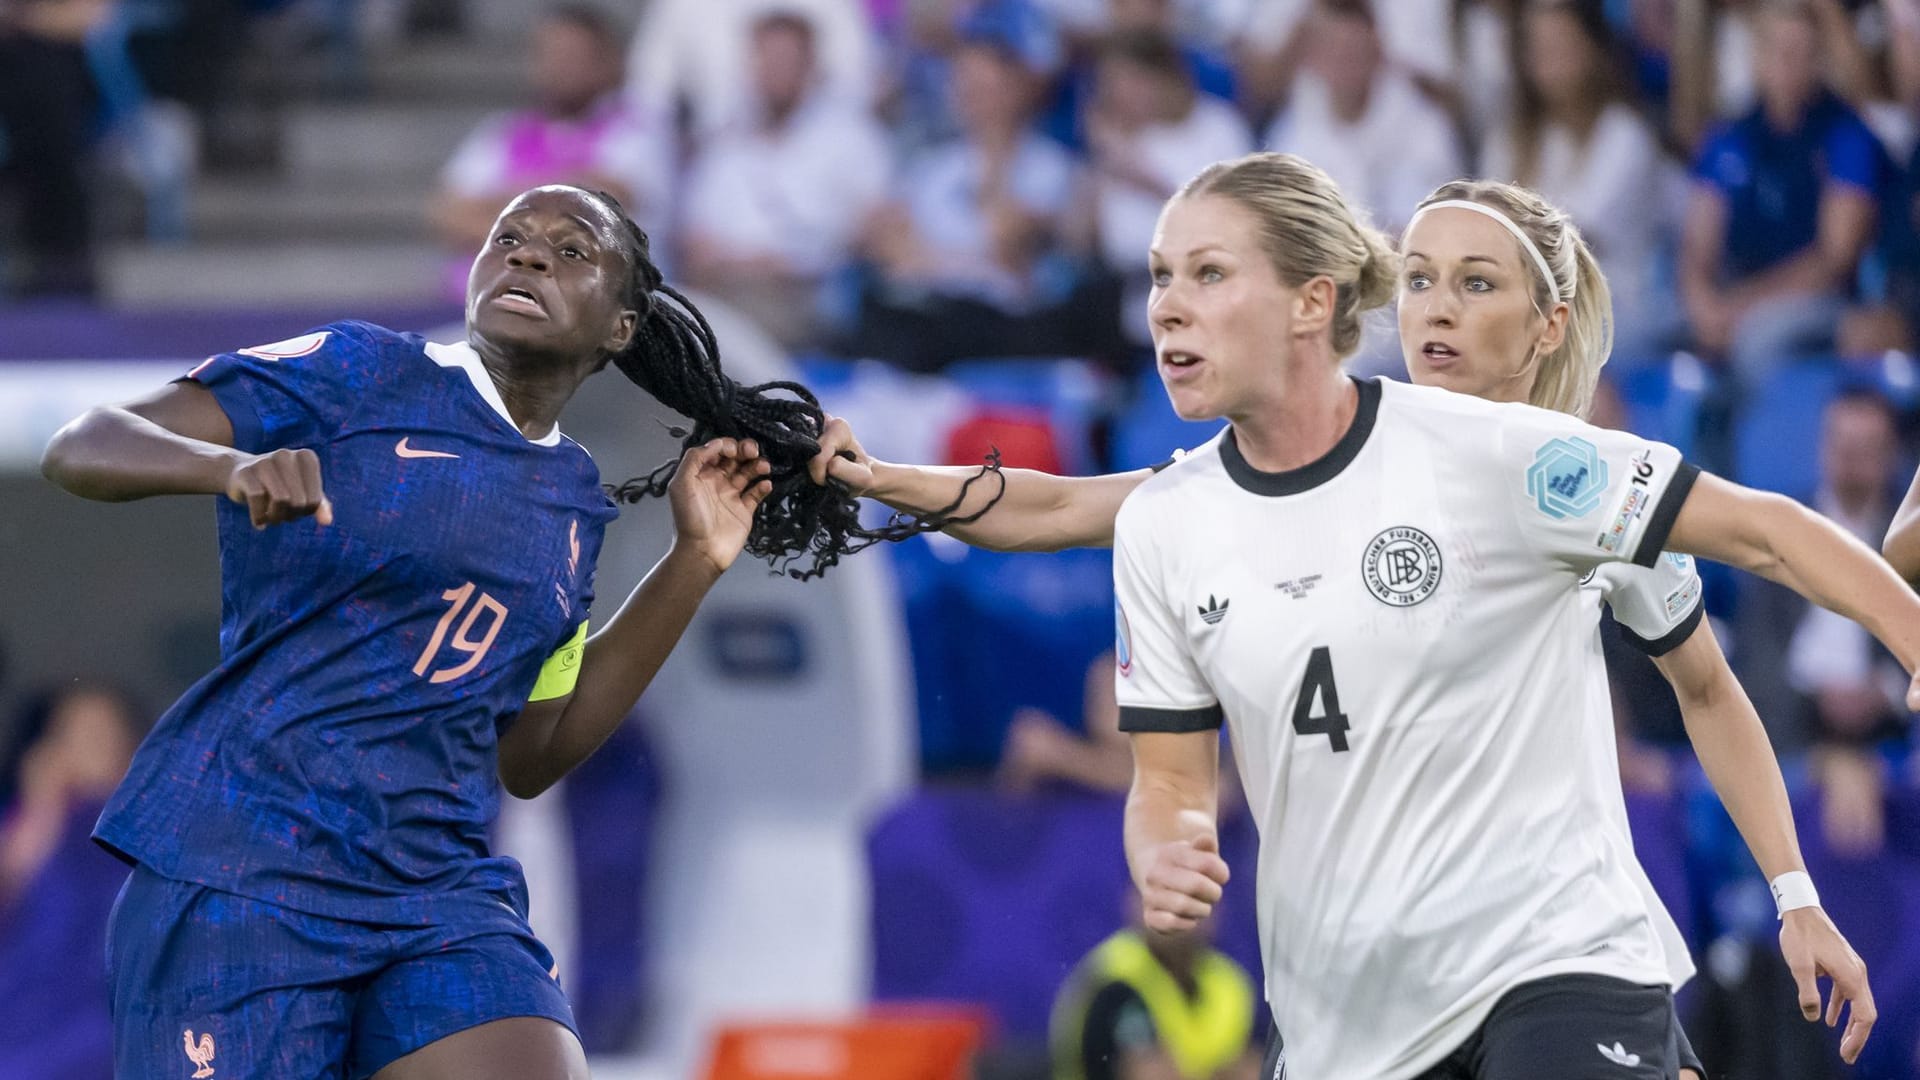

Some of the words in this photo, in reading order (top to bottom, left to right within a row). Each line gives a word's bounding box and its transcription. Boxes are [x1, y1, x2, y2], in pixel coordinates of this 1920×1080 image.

[1631, 461, 1654, 487] 10
[1367, 537, 1390, 599] DEUTSCHER
[412, 581, 508, 683] 19
[1292, 646, 1351, 753] 4
